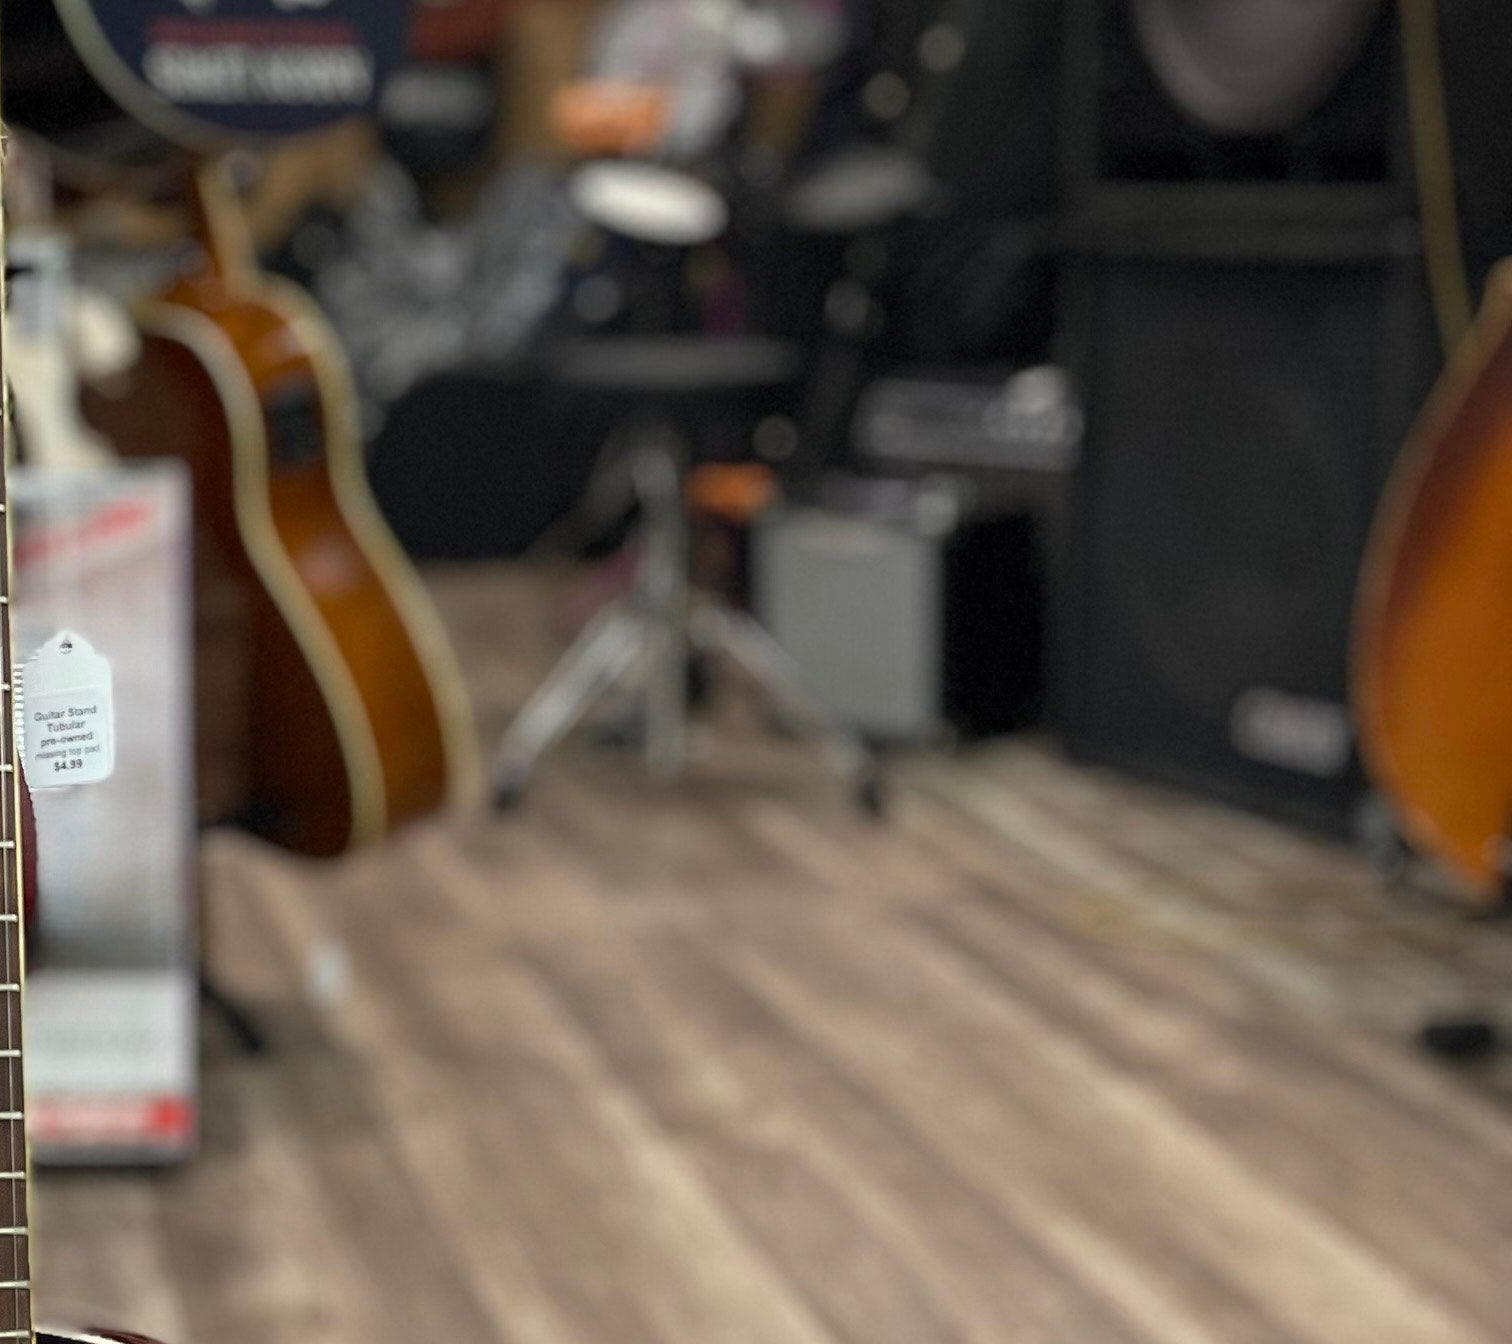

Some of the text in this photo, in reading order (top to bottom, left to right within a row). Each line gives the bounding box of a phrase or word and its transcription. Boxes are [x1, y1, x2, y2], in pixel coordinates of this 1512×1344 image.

[34, 705, 97, 722] Guitar Stand
[47, 721, 85, 733] Tubular
[40, 731, 93, 749] pre-owned
[54, 758, 83, 772] $4.99
